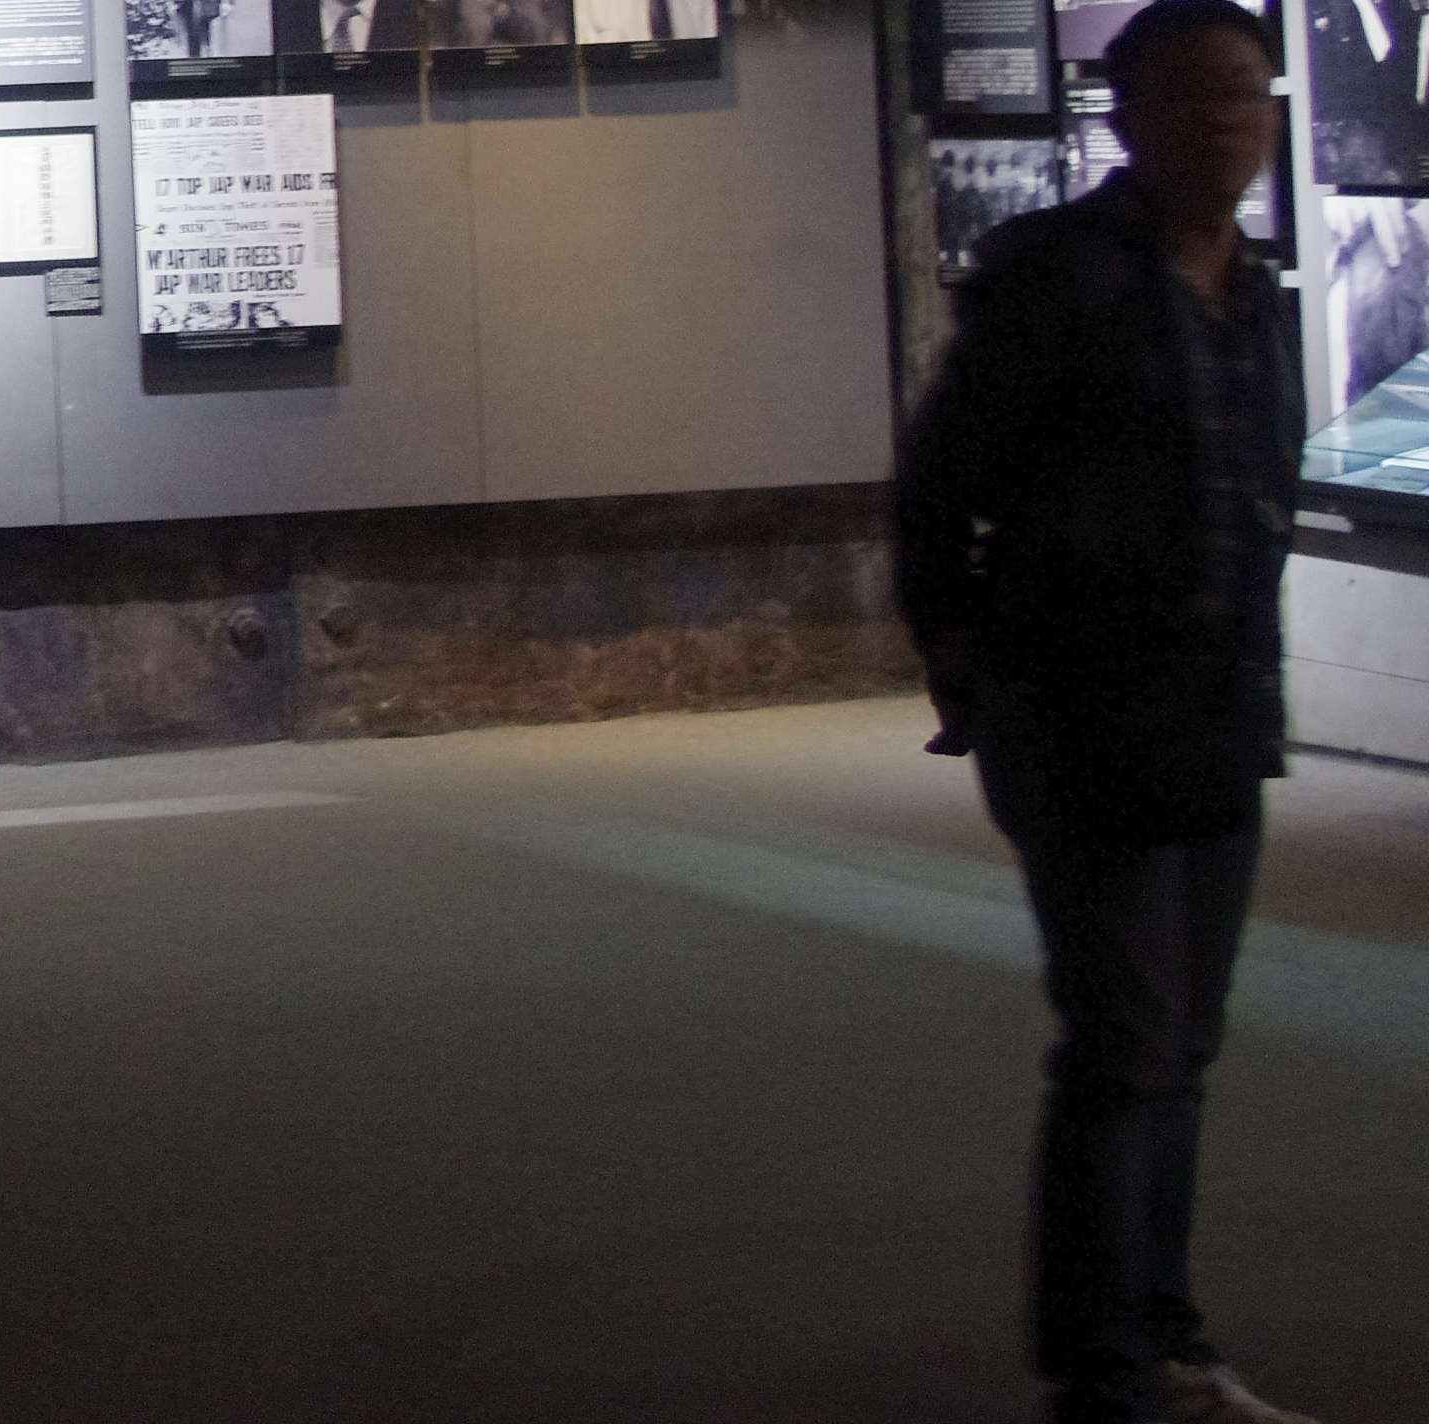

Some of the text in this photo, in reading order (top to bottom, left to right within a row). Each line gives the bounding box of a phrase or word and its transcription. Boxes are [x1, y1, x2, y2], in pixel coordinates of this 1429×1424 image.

[208, 176, 233, 196] JAP
[240, 174, 272, 193] WAR
[234, 245, 281, 266] FREES
[153, 269, 298, 295] JAP WAR LEADERS
